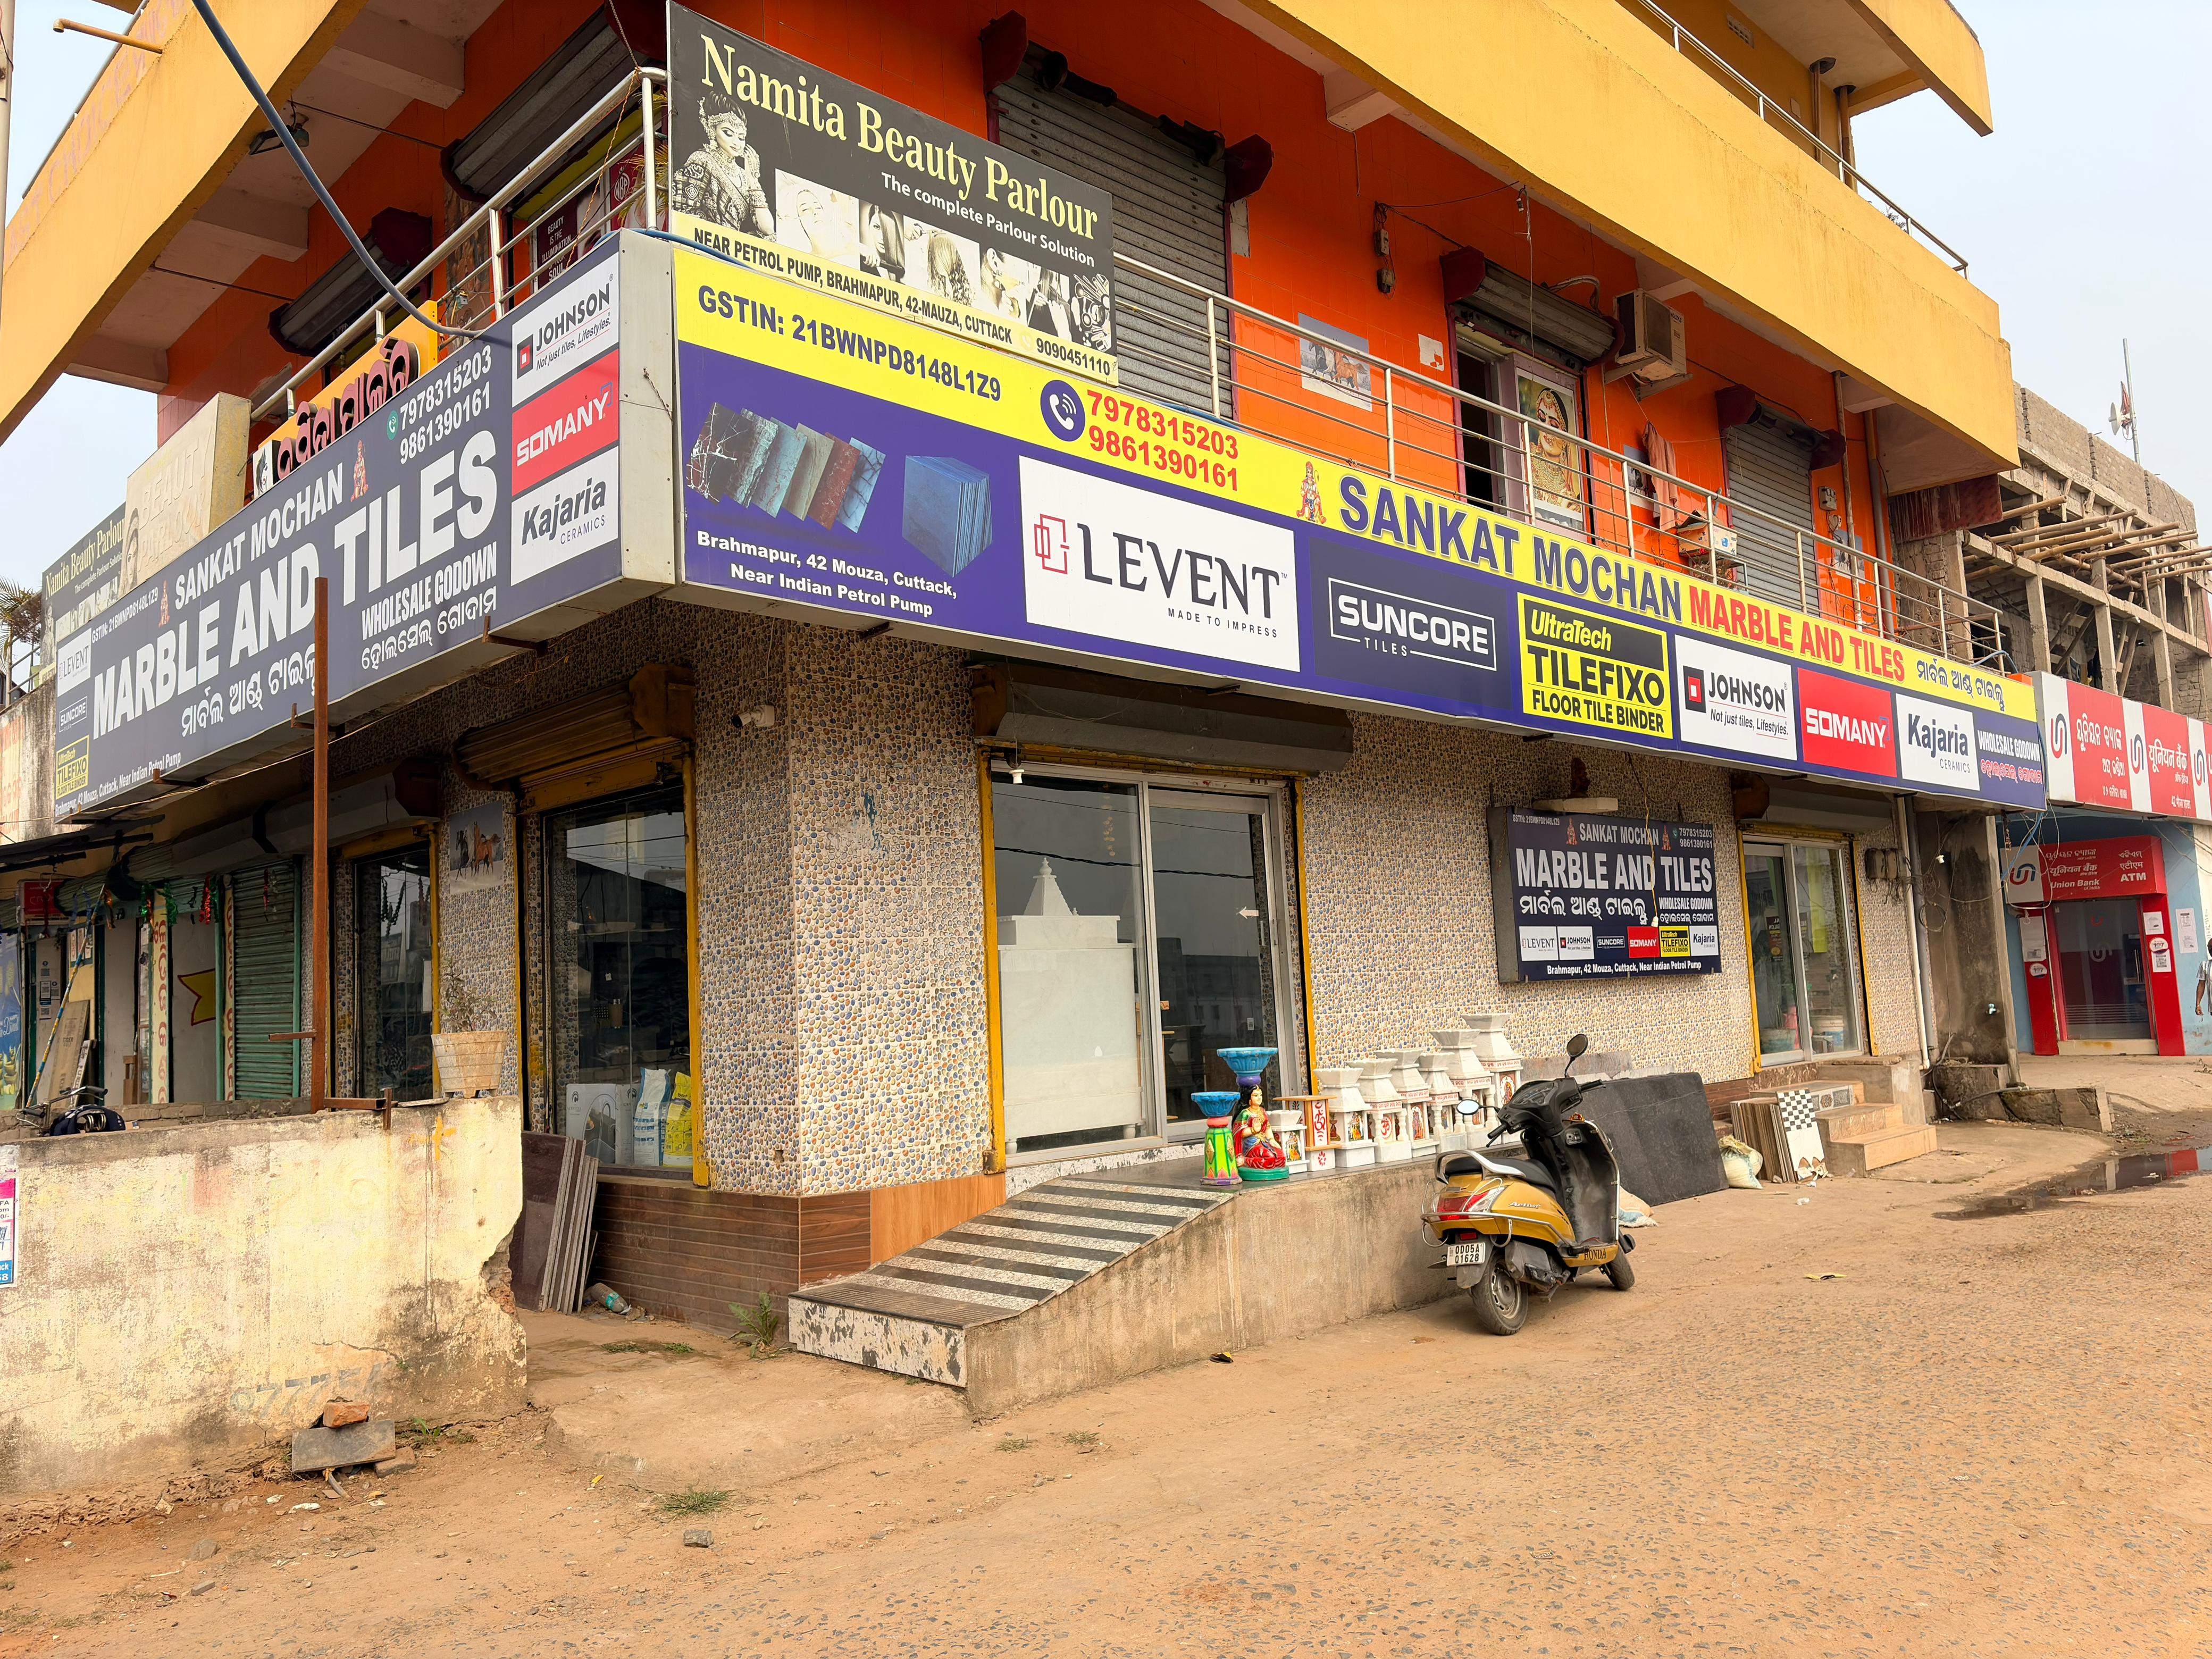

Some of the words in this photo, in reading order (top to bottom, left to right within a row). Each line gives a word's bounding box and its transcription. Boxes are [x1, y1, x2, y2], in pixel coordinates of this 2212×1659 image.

[700, 34, 847, 141] Namita
[856, 102, 977, 200] Beauty
[984, 156, 1098, 240] Parlour
[548, 215, 564, 234] BEAUTY
[881, 171, 910, 196] The
[914, 188, 983, 224] complete
[986, 213, 1037, 245] Parlour
[1040, 234, 1095, 267] Solution
[542, 234, 571, 263] ILLUMINATION
[549, 236, 554, 245] IS
[554, 229, 563, 241] THE
[548, 262, 565, 281] SOUL
[694, 228, 731, 255] NEAR
[734, 241, 784, 272] PETROL
[787, 258, 823, 288] PUMP,
[827, 270, 903, 312] BRAHMAPUR,
[906, 295, 962, 331] 42-MAUZA,
[965, 321, 1012, 345] CUTTACK
[536, 282, 610, 351] JOHNSON
[1670, 312, 1682, 323] VOLTAS
[537, 355, 547, 371] Not
[548, 346, 560, 366] just
[561, 339, 576, 355] tiles,
[578, 317, 611, 345] Lifestyles.
[698, 285, 784, 335] GSTIN:
[792, 314, 1001, 402] 21BWNPD8148L1Z9
[1036, 338, 1110, 376] 9090451110
[400, 345, 492, 431] 7978315203
[400, 382, 490, 465] 9861390161
[516, 390, 609, 467] SOMANY
[1087, 389, 1238, 459] 7978315203
[1089, 425, 1237, 491] 9861390161
[521, 476, 607, 546] Kajaria
[175, 531, 246, 610] SANKAT
[250, 462, 343, 556] MOCHAN
[560, 514, 606, 544] CERAMICS
[45, 561, 70, 600] Namita
[70, 539, 96, 580] Beauty
[697, 530, 801, 568] Brahmapur,
[806, 554, 827, 571] 42
[832, 558, 888, 586] Mouza,
[893, 572, 957, 599] Cuttack,
[1077, 522, 1280, 619] LEVENT
[1338, 475, 1520, 574] SANKAT
[1533, 536, 1682, 623] MOCHAN
[1689, 586, 1794, 652] MARBLE
[1800, 621, 1845, 666] AND
[1850, 637, 1905, 683] TILES
[93, 600, 220, 740] MARBLE
[230, 542, 319, 668] AND
[334, 430, 497, 606] TILES
[362, 575, 431, 641] WHOLESALE
[434, 541, 497, 605] GODOWN
[731, 564, 774, 586] Near
[780, 574, 832, 597] Indian
[837, 584, 885, 607] Petrol
[890, 594, 933, 618] Pump
[91, 623, 108, 643] GSTIN:
[108, 586, 158, 633] 21BWNPD8148L1Z9
[437, 586, 497, 634] ଗୋଦାମ
[1168, 608, 1200, 623] MADE
[1206, 615, 1221, 627] TO
[1227, 620, 1277, 638] IMPRESS
[1337, 594, 1489, 656] SUNCORE
[1365, 638, 1408, 657] TILES
[1530, 609, 1612, 651] UltraTech
[63, 646, 89, 678] LEVENT
[1527, 645, 1664, 706] TILEFIXO
[1916, 658, 1948, 688] ମାର୍ବଲ
[1708, 671, 1787, 713] JOHNSON
[60, 701, 86, 727] SUNCORE
[181, 686, 224, 738] ମାର୍ବଲ
[1532, 690, 1581, 718] FLOOR
[1583, 699, 1613, 724] TILE
[1616, 705, 1664, 733] BINDER
[1711, 708, 1724, 723] Not
[1724, 710, 1738, 727] just
[1739, 714, 1754, 731] tiles,
[1756, 718, 1788, 737] Lifestyles.
[1805, 708, 1887, 748] SOMANY
[1908, 713, 1968, 758] Kajaria
[1978, 730, 2014, 756] WHOLESALE
[2014, 739, 2041, 761] GODOWN
[57, 759, 87, 785] TILEFIXO
[58, 747, 76, 765] UltraTech
[1940, 758, 1970, 773] CERAMICS
[2148, 738, 2175, 773] यूनियन
[2175, 743, 2188, 770] बैंक
[57, 784, 66, 796] FLOOR
[74, 775, 86, 789] BINDER
[83, 789, 98, 803] Mouza,
[99, 778, 118, 798] Cuttack,
[119, 773, 131, 788] Near
[132, 766, 147, 784] Indian
[149, 756, 164, 776] Petrol
[165, 752, 181, 770] Pump
[1512, 814, 1526, 823] GSTIN:
[1526, 816, 1560, 826] 21BWNPD8148L1Z9
[1579, 823, 1618, 843] SANKAT
[1620, 826, 1659, 846] MOCHAN
[1679, 828, 1712, 838] 7978315203
[1680, 839, 1713, 848] 9861390161
[1515, 848, 1609, 890] MARBLE
[1614, 854, 1655, 891] AND
[1660, 856, 1713, 892] TILES
[2050, 865, 2081, 876] यूनियन
[2119, 860, 2143, 870] एटीएम
[2120, 872, 2146, 882] ATM
[1520, 890, 1566, 916] ମାର୍ବଲ
[1658, 897, 1690, 910] WHOLESALE
[1690, 898, 1713, 910] GODOWN
[1527, 938, 1555, 948] LEVENT
[1661, 939, 1688, 947] TILEFIXO
[1693, 933, 1715, 945] Kajaria
[1547, 965, 1582, 976] Brahmapur,
[1583, 964, 1591, 973] 42
[1593, 963, 1613, 974] Mouza,
[1614, 962, 1638, 973] Cuttack,
[1639, 962, 1652, 971] Near
[1653, 961, 1670, 970] Indian
[1671, 960, 1687, 969] Petrol
[1687, 960, 1702, 970] Pump
[1455, 1243, 1480, 1254] OD05A
[1455, 1253, 1479, 1264] Q1628
[1583, 1248, 1606, 1260] HONDA
